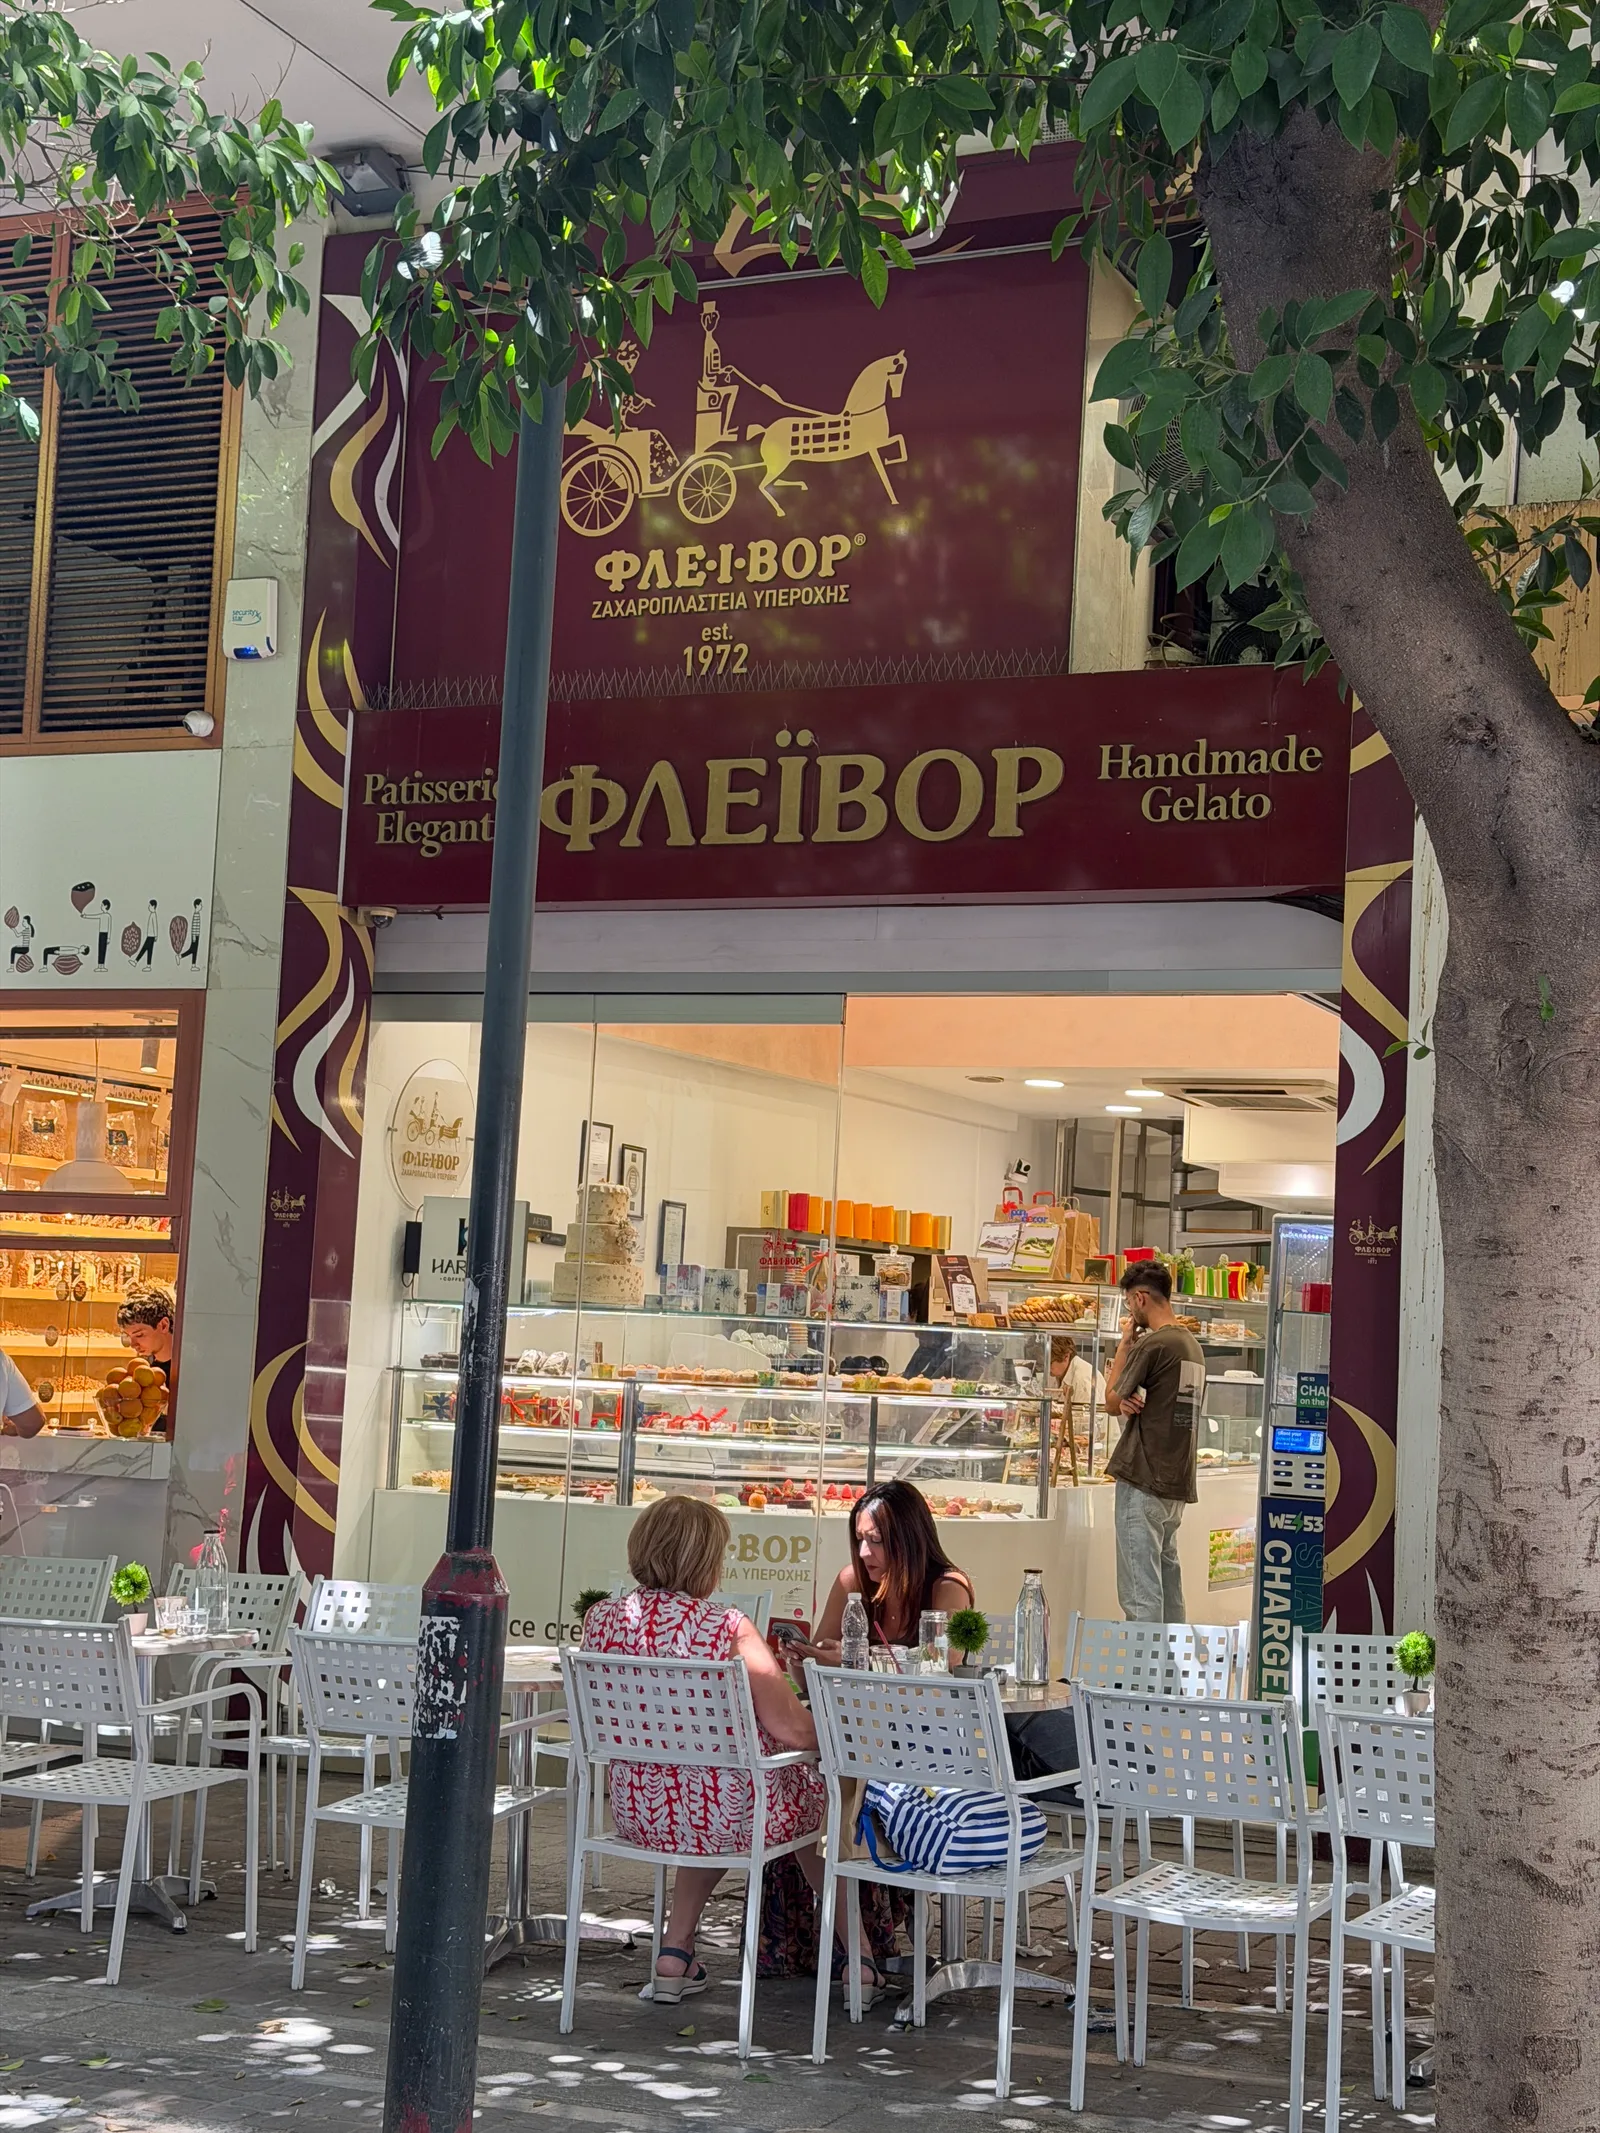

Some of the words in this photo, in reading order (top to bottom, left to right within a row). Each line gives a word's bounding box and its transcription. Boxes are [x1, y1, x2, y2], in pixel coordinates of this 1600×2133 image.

[591, 592, 748, 619] ΖΑΧΑΡΟΠΛΑΣΤΕΙΑ
[753, 584, 850, 609] ΥΠΕΡΟΧΗΣ
[701, 623, 733, 641] est.
[683, 643, 749, 677] 1972
[1097, 735, 1324, 780] Handmade
[539, 729, 1064, 852] ΦΛΕΪΒΟΡ
[1140, 783, 1272, 823] Gelato
[1300, 1385, 1329, 1397] CHA
[1312, 1397, 1325, 1406] the
[743, 1568, 811, 1581] ΥΠΕΡΟΧΗΣ
[544, 1622, 583, 1642] cre
